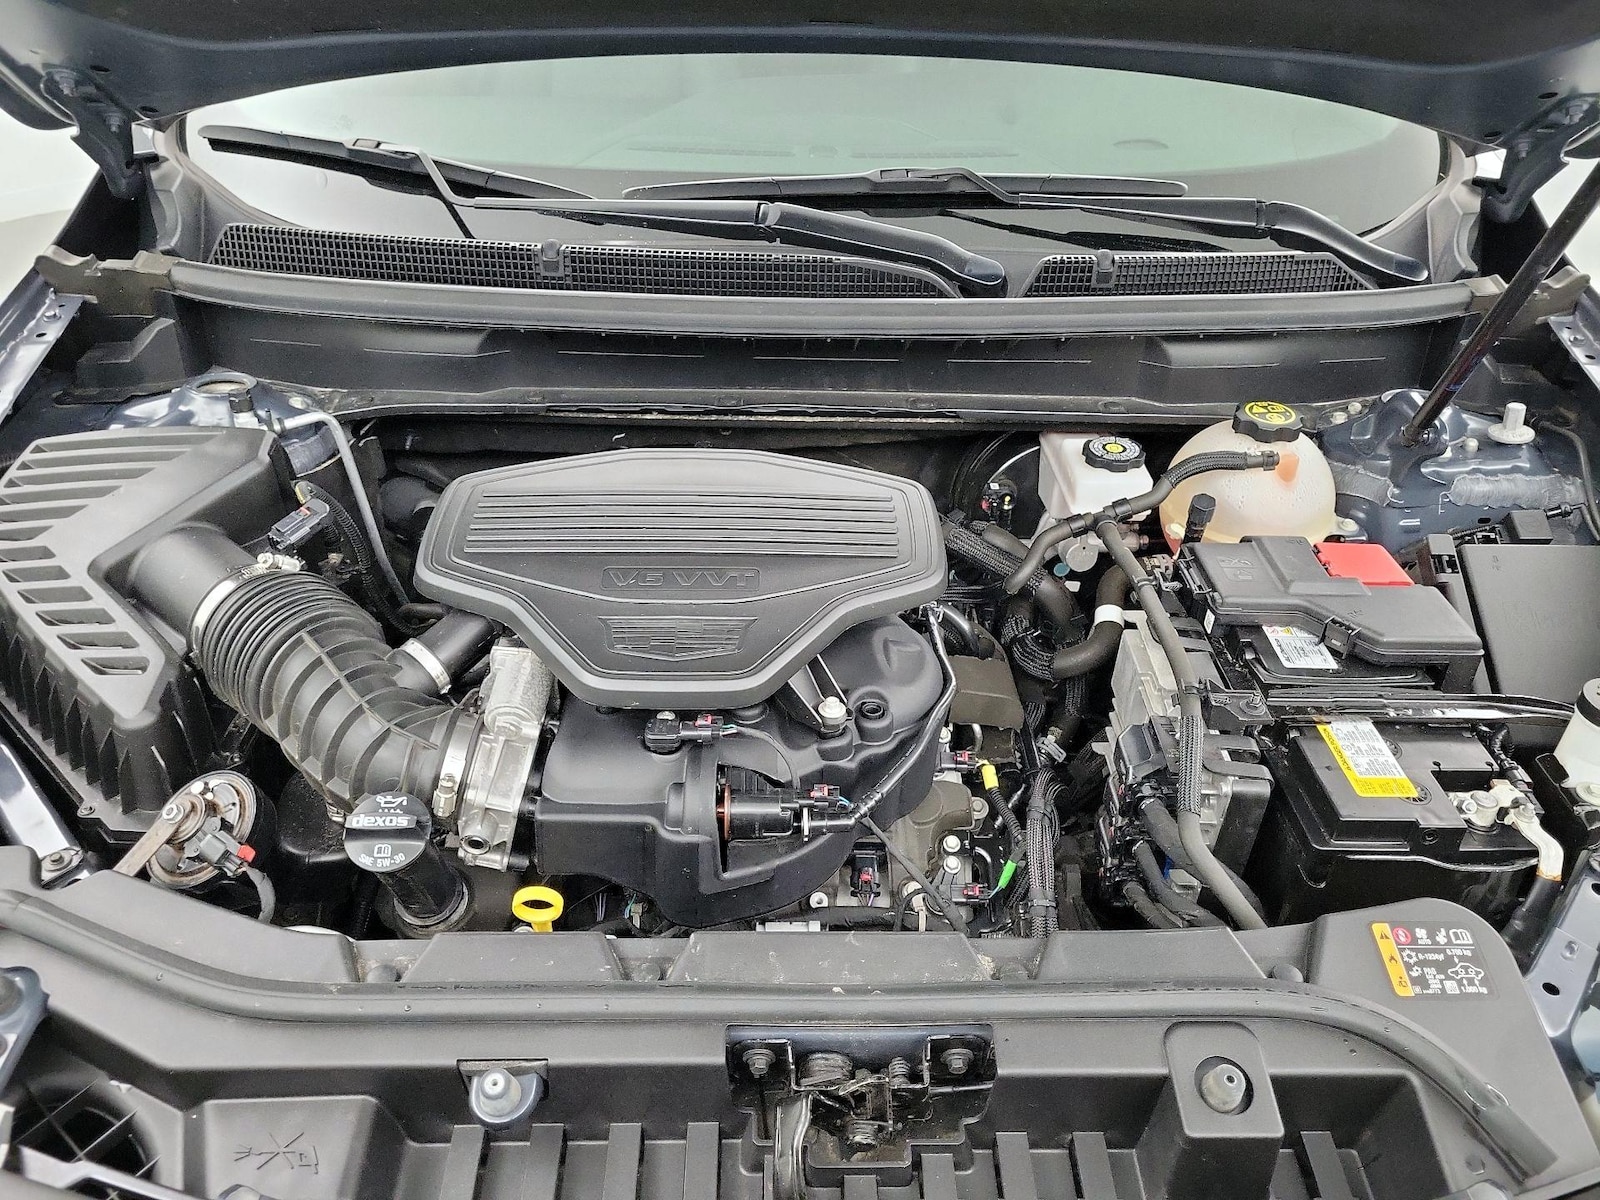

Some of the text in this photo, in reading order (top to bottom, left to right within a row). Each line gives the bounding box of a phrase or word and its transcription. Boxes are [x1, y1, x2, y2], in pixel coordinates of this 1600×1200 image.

[609, 570, 755, 586] V6 VVT
[352, 814, 410, 827] dexos
[358, 852, 406, 867] SAE 5W-30
